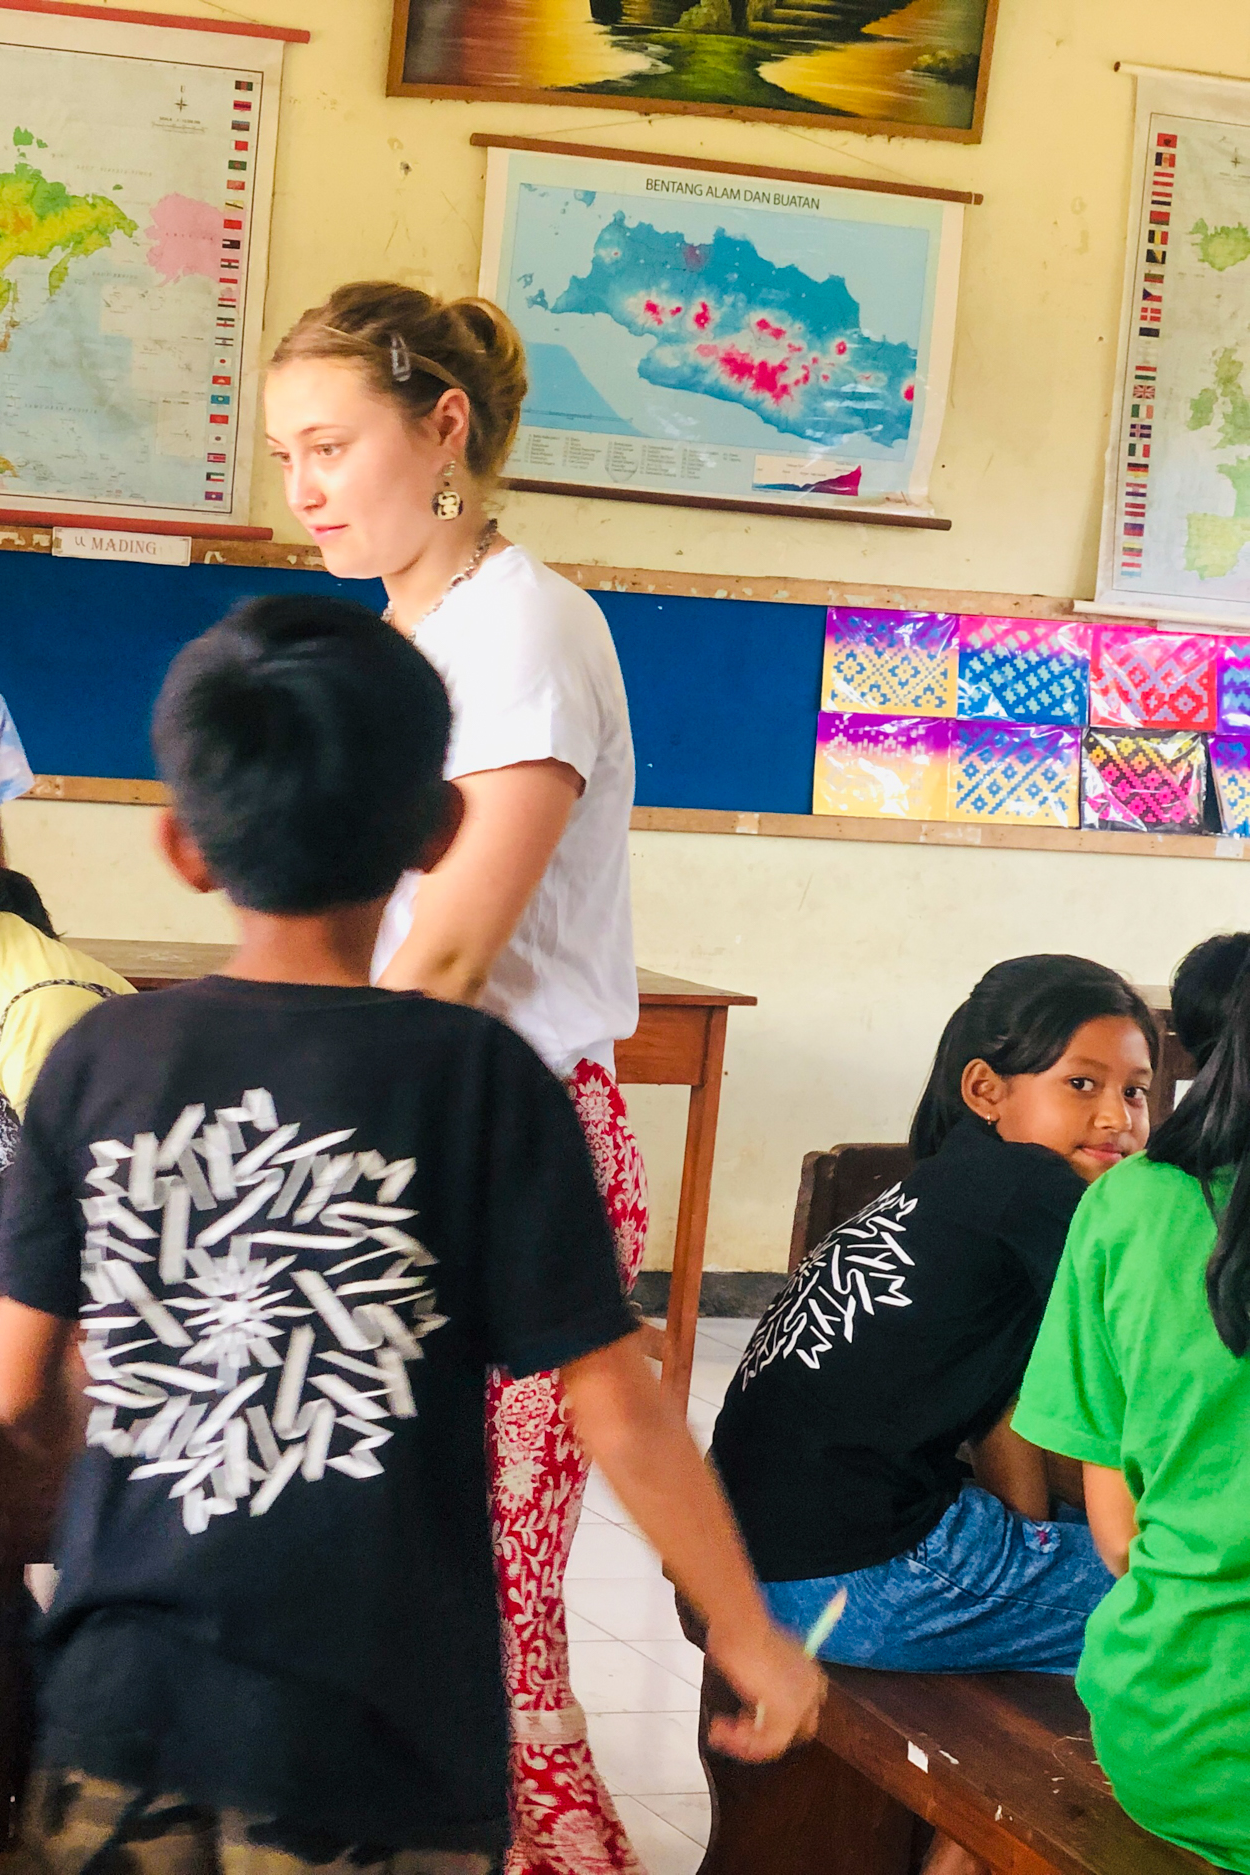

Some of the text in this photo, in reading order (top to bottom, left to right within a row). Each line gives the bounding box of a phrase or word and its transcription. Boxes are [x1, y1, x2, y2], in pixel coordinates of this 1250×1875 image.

[645, 178, 820, 210] BENTANG ALAM DAN BUATAN
[91, 537, 157, 554] MADING
